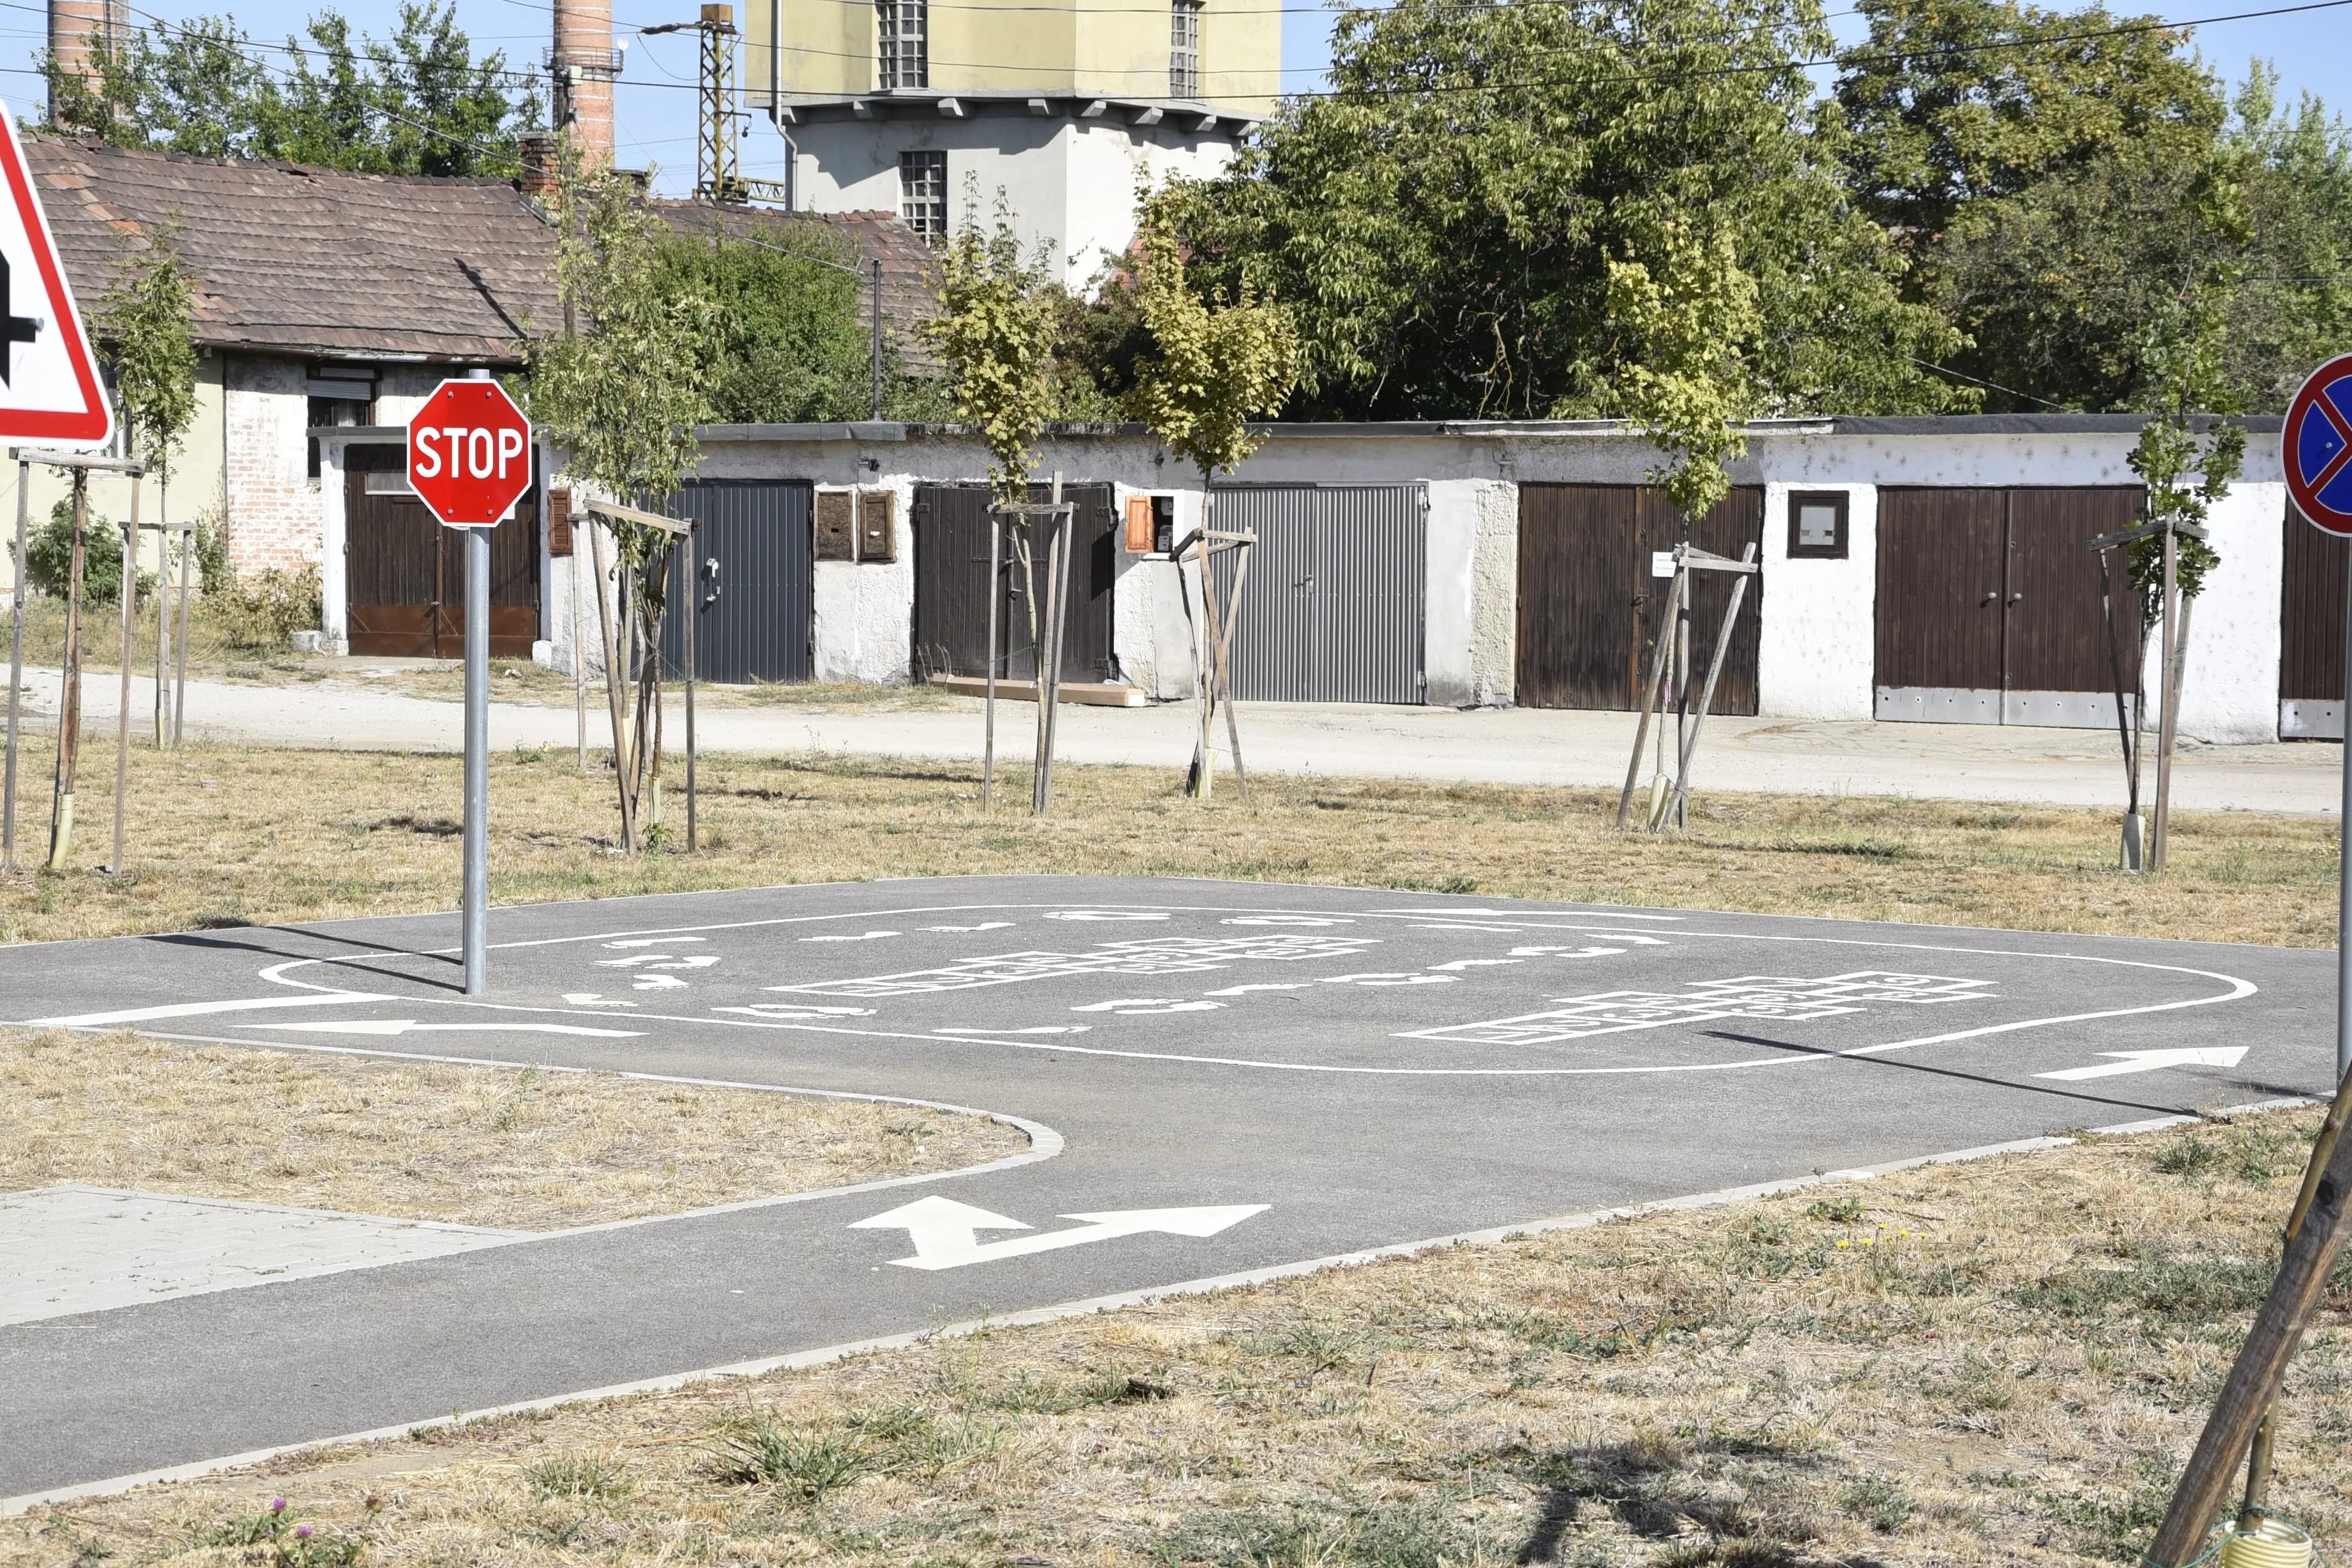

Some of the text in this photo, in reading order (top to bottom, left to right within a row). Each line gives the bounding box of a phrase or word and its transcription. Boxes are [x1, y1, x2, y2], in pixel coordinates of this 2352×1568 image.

[415, 426, 523, 479] STOP
[1866, 977, 1930, 986] 9
[1625, 997, 1677, 1005] 4
[1731, 1005, 1808, 1013] 5
[1602, 1010, 1673, 1018] 3
[1520, 1020, 1600, 1030] 2
[1475, 1031, 1540, 1040] 1
